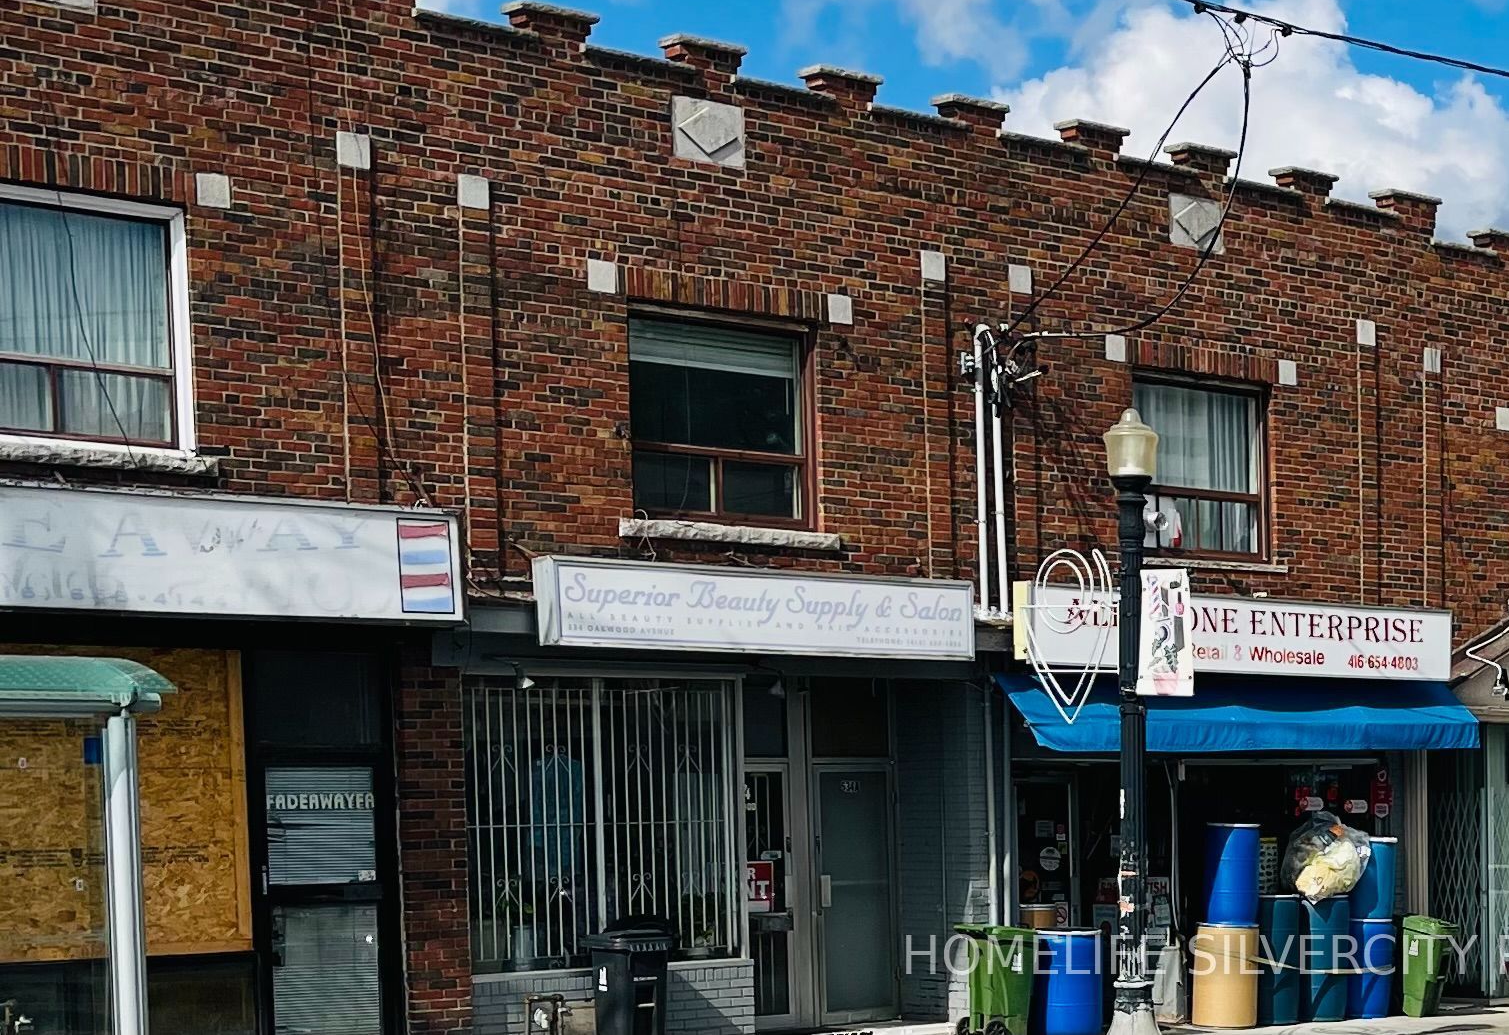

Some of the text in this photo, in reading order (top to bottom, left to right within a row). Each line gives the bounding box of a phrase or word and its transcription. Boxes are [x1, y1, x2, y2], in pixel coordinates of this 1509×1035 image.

[565, 573, 962, 628] Superior Beauty Supply & Salon
[587, 624, 636, 634] OAKWOOD
[1250, 609, 1424, 643] ENTERPRISE
[1250, 645, 1325, 664] Wholesale
